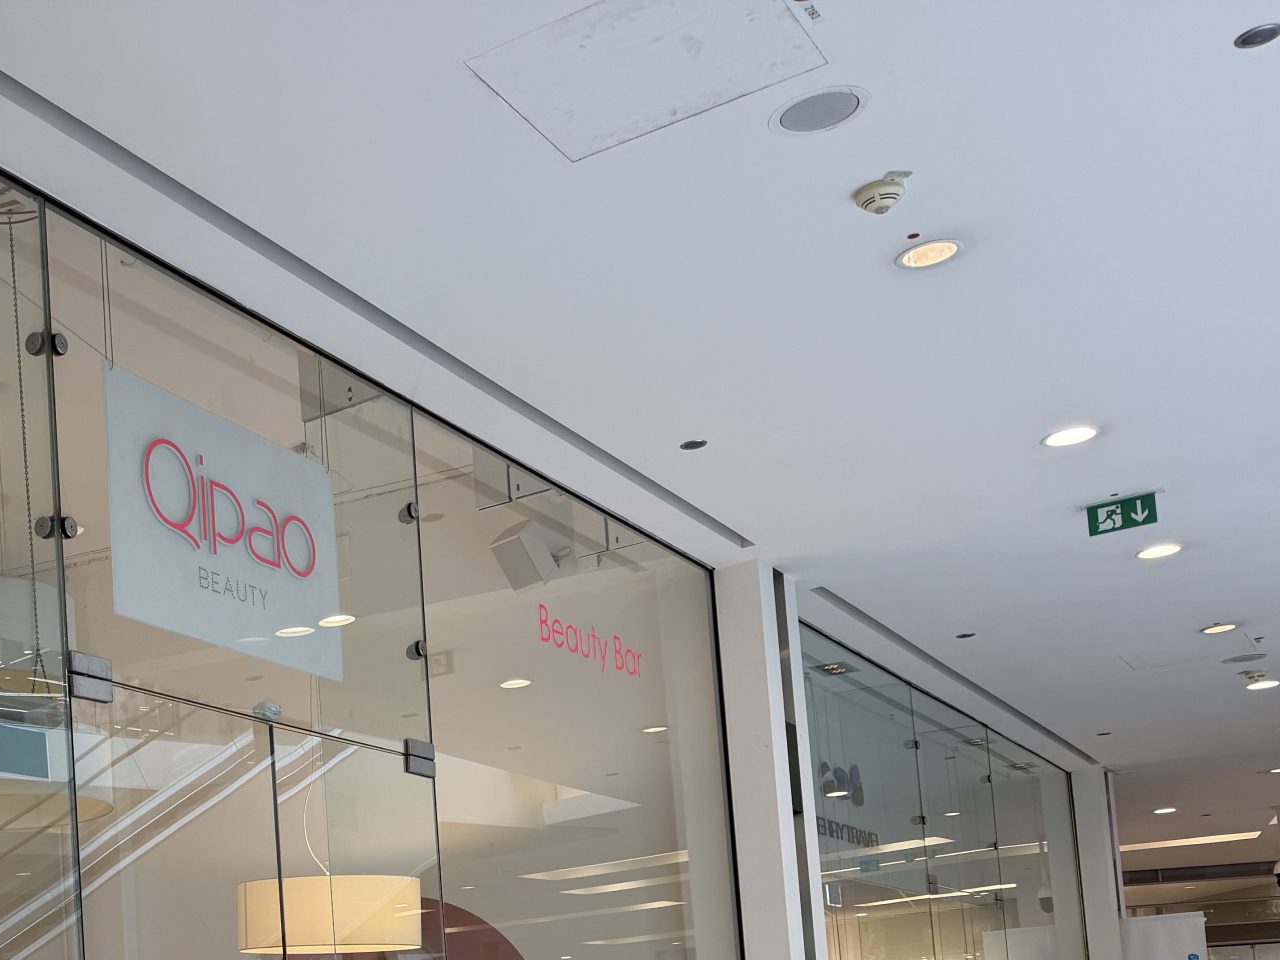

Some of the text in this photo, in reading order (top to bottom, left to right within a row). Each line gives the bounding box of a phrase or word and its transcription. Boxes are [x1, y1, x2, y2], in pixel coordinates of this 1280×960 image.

[144, 438, 316, 578] Qipao
[198, 566, 269, 609] BEAUTY
[538, 603, 642, 679] Beauty Bar
